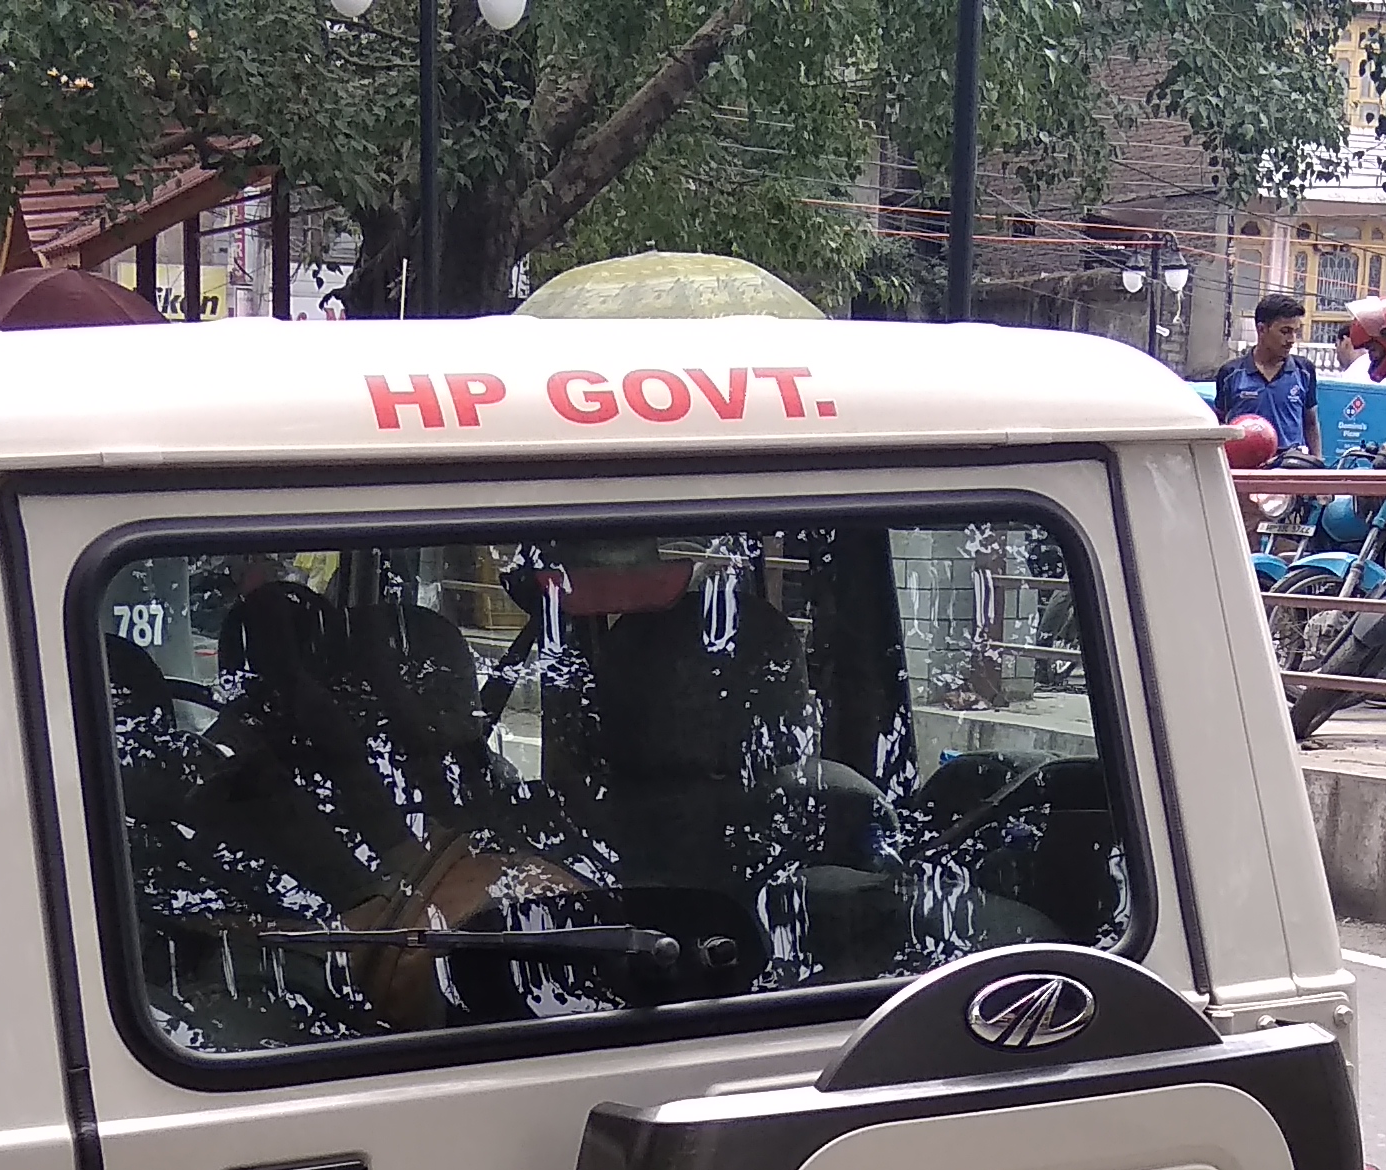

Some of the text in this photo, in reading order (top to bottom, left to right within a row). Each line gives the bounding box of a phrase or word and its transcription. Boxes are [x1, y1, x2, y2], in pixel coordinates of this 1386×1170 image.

[364, 366, 839, 430] HP GOVT.
[113, 604, 165, 647] 787
